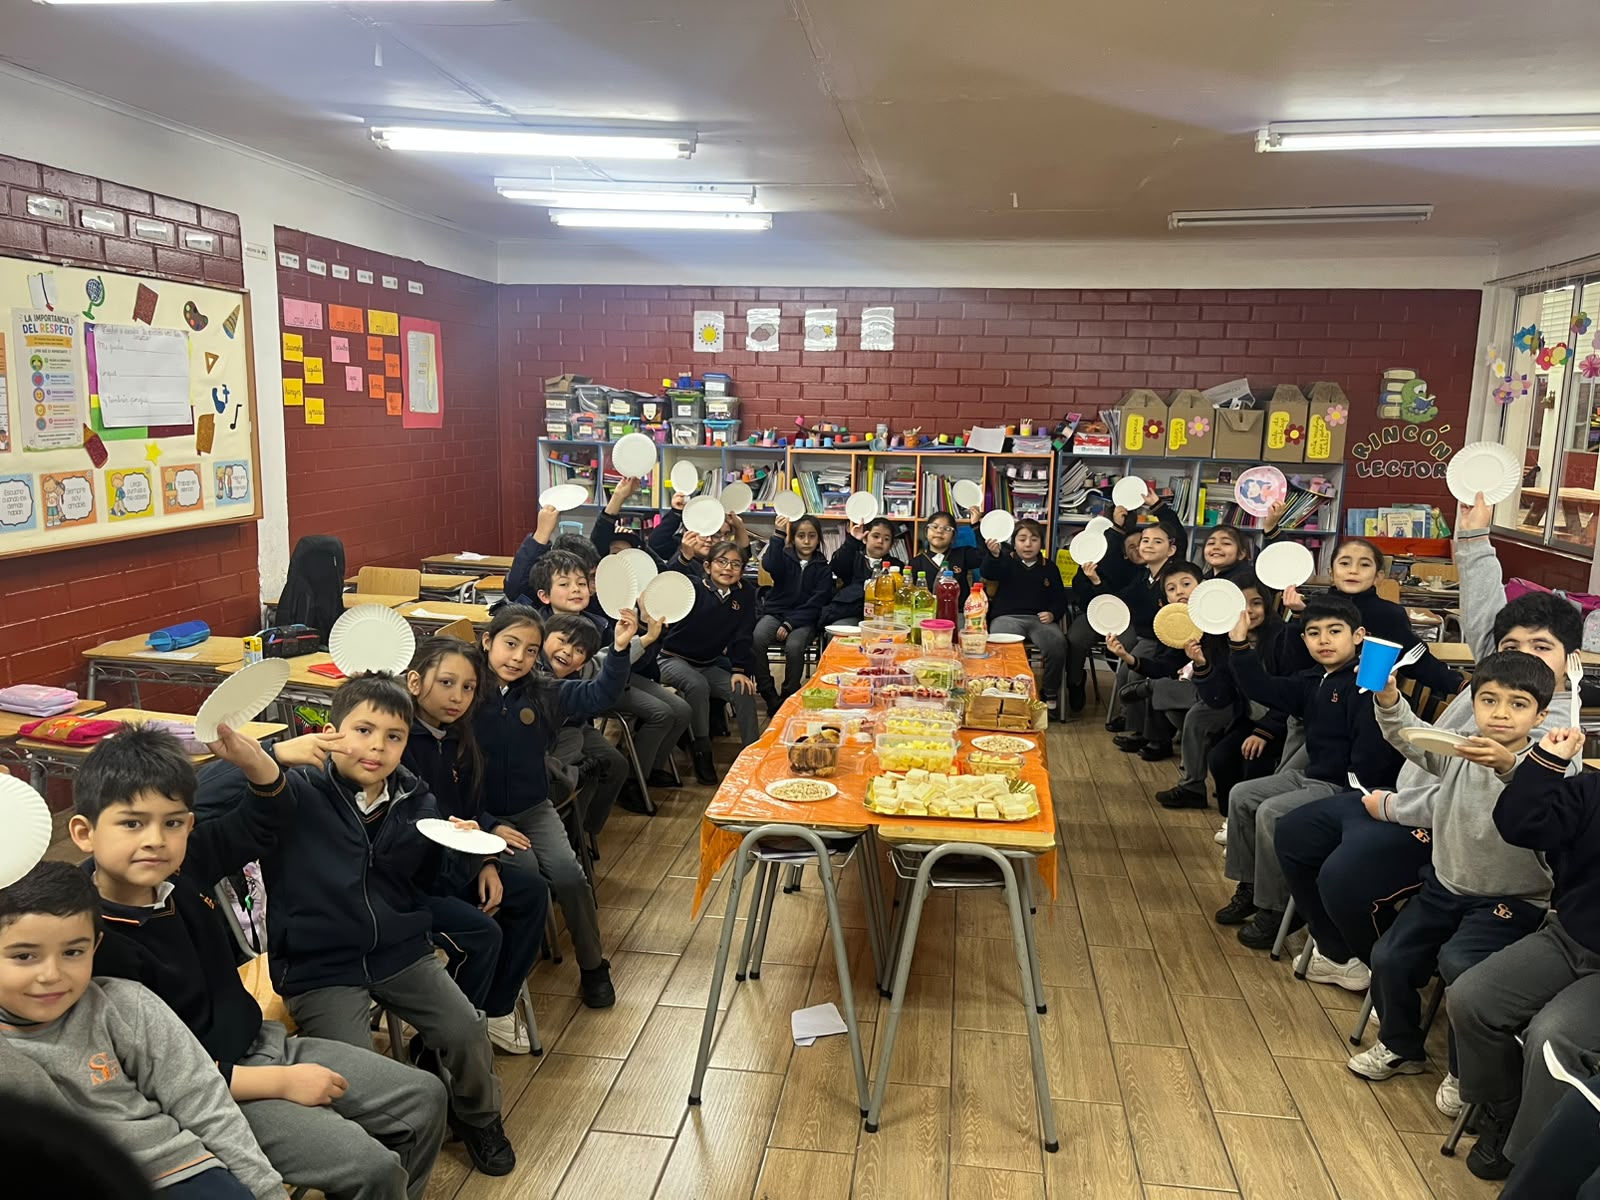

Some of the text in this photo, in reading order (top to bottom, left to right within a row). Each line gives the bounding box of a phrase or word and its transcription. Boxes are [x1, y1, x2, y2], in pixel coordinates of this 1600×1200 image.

[34, 314, 70, 324] IMPORTANCIA
[22, 323, 73, 336] DEL RESPETO
[1352, 425, 1452, 461] RINCÓN
[1356, 460, 1447, 479] LECTOR
[66, 487, 87, 495] Siempre
